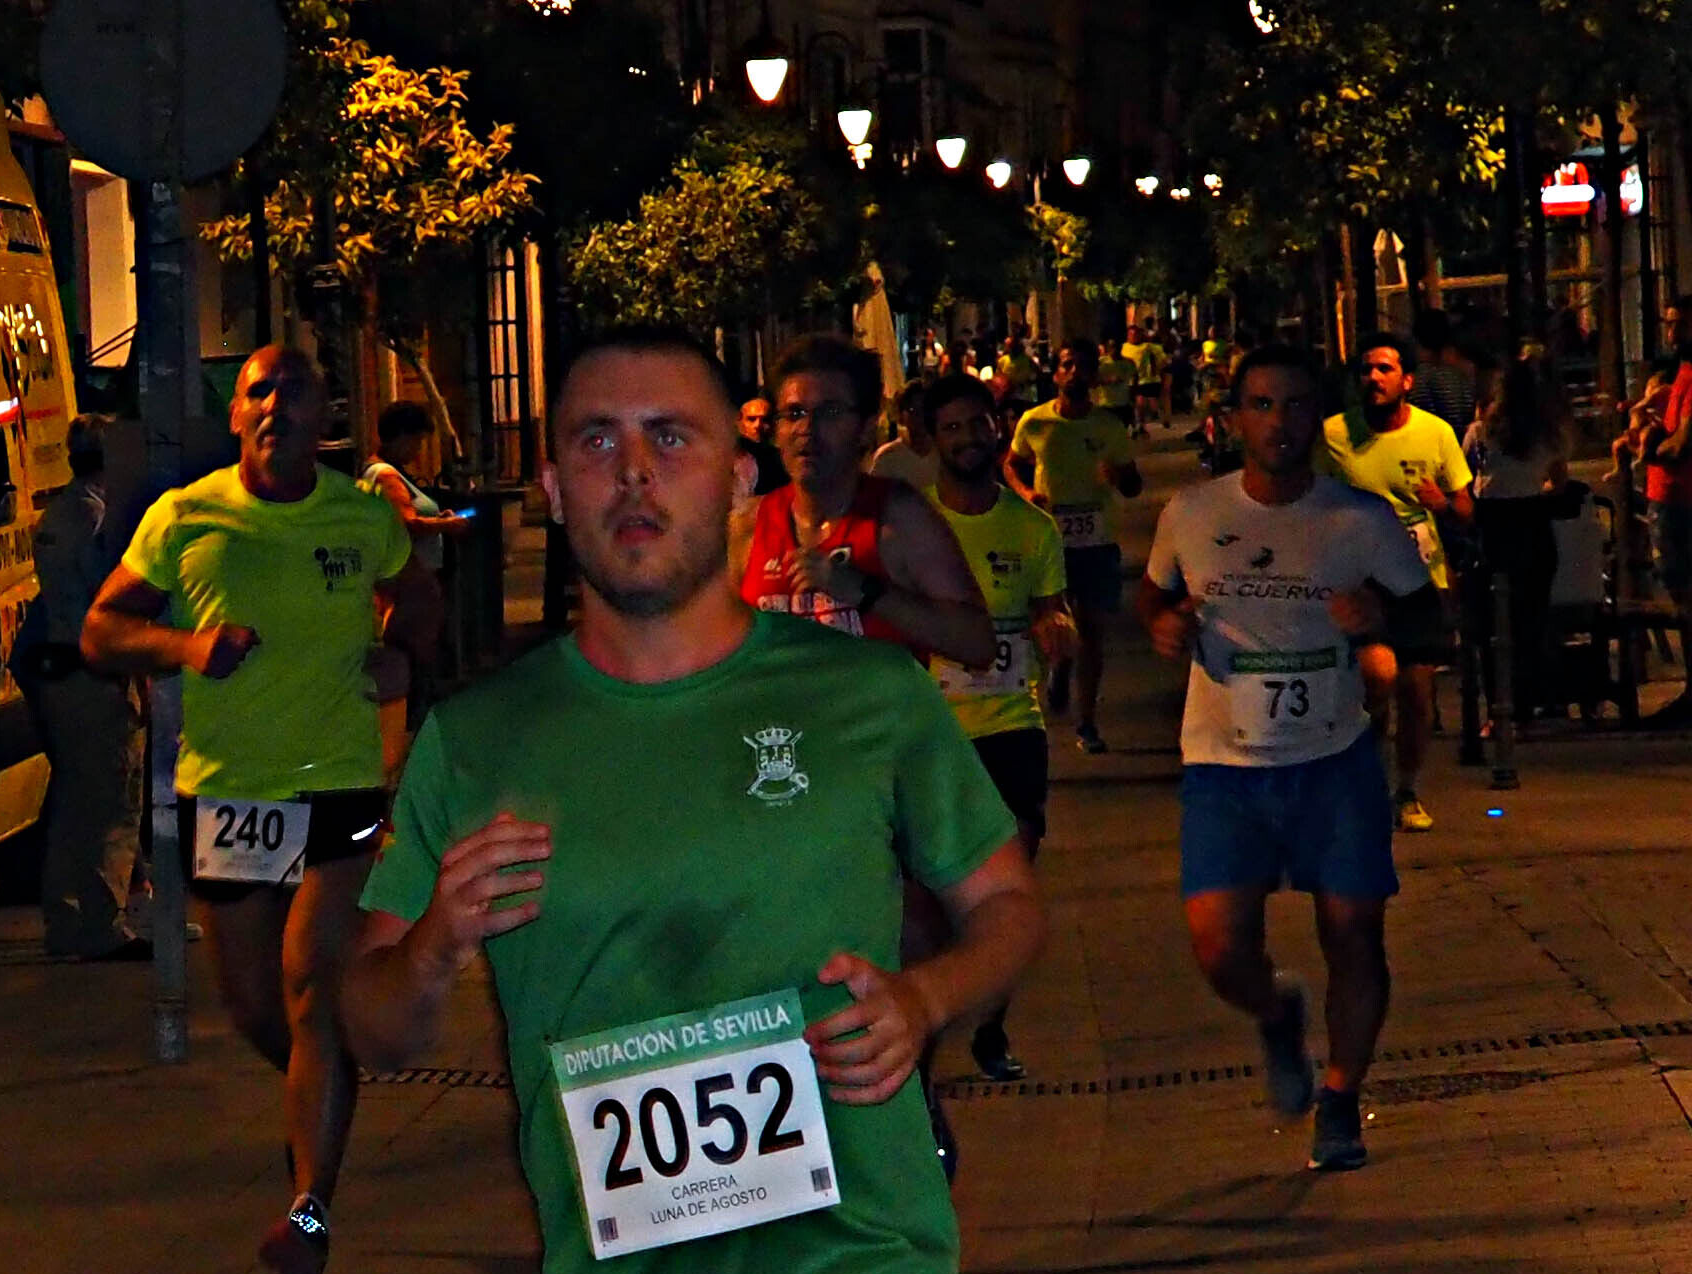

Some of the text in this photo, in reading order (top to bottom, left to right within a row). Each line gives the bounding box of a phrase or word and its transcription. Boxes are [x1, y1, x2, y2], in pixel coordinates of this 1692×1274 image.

[1204, 581, 1229, 597] EL
[1264, 679, 1310, 719] 73
[214, 805, 284, 851] 240
[564, 1004, 792, 1076] DIPUTACION DE SEVILLA
[593, 1062, 805, 1191] 2052
[650, 1187, 768, 1225] LUNA DE AGOSTO
[671, 1174, 739, 1201] CARRERA
